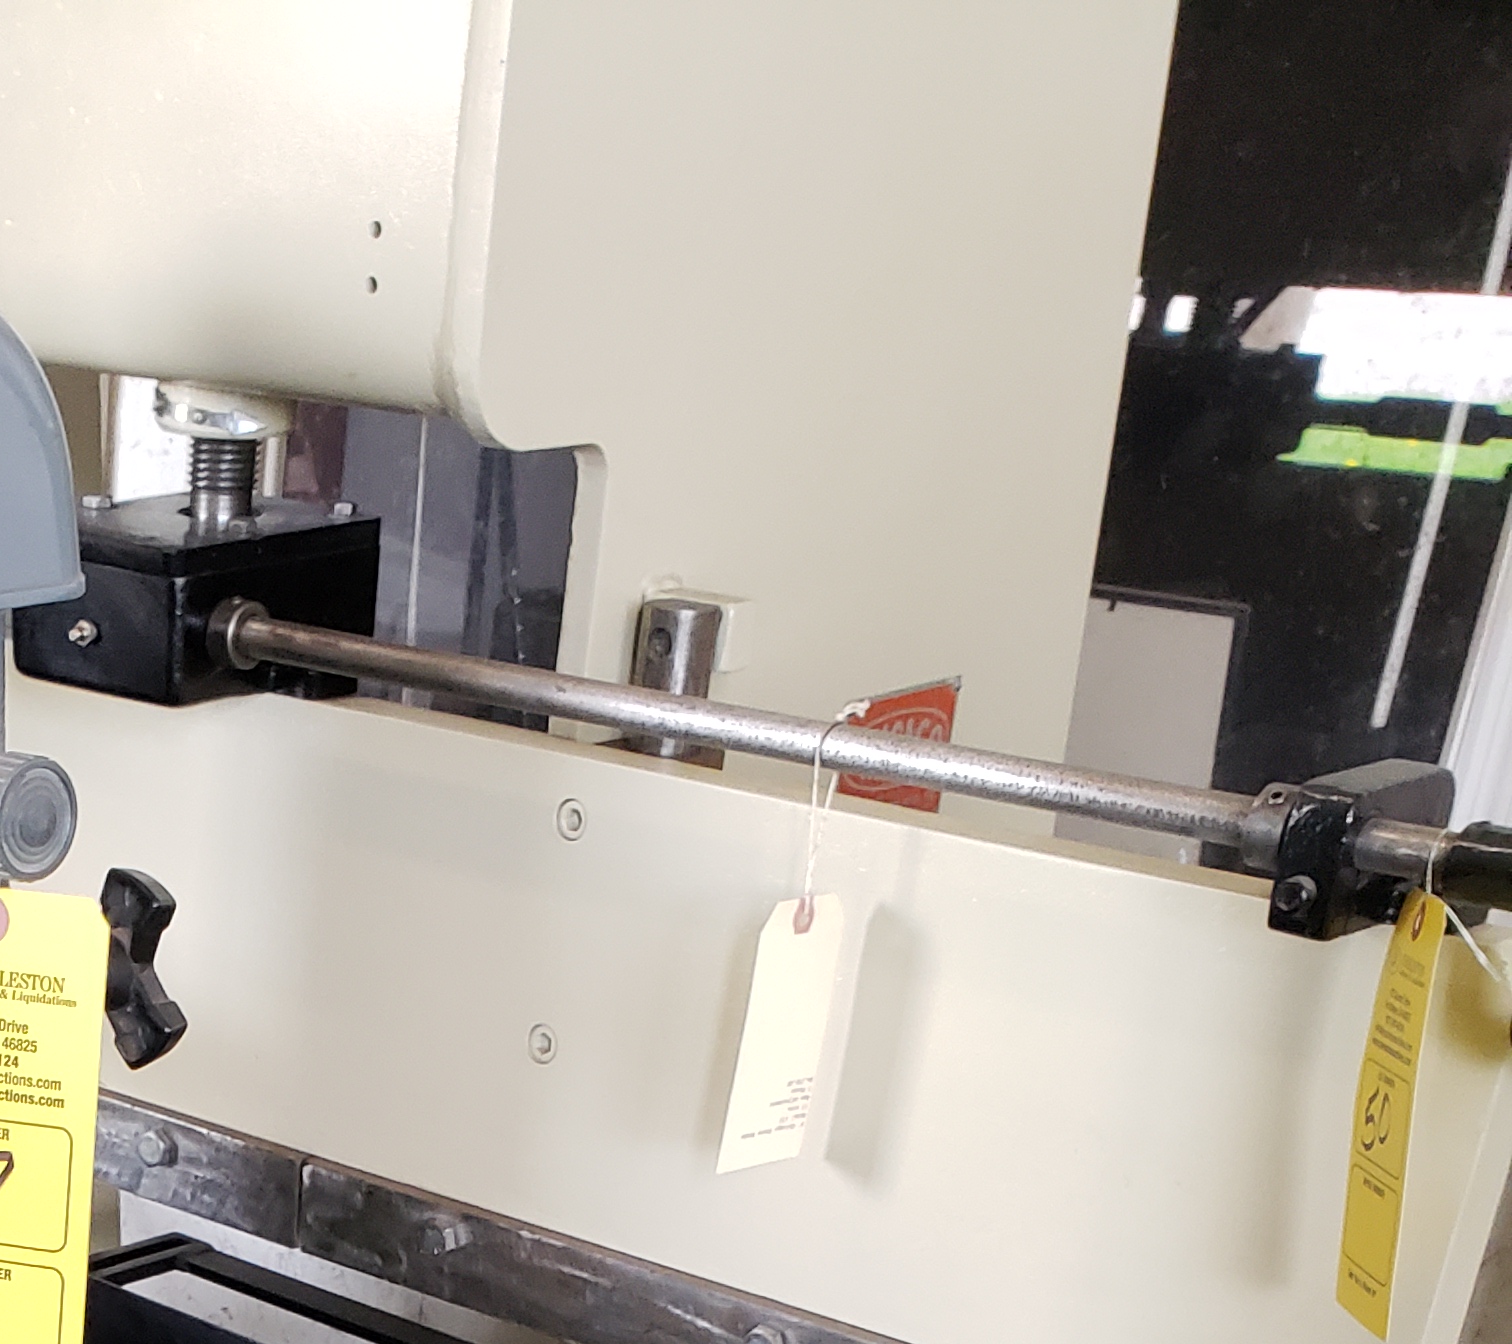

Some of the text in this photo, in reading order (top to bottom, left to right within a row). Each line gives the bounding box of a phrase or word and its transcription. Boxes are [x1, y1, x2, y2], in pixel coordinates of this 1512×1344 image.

[0, 988, 9, 1000] &
[11, 990, 77, 1008] Liquidations
[2, 1037, 38, 1053] 46825
